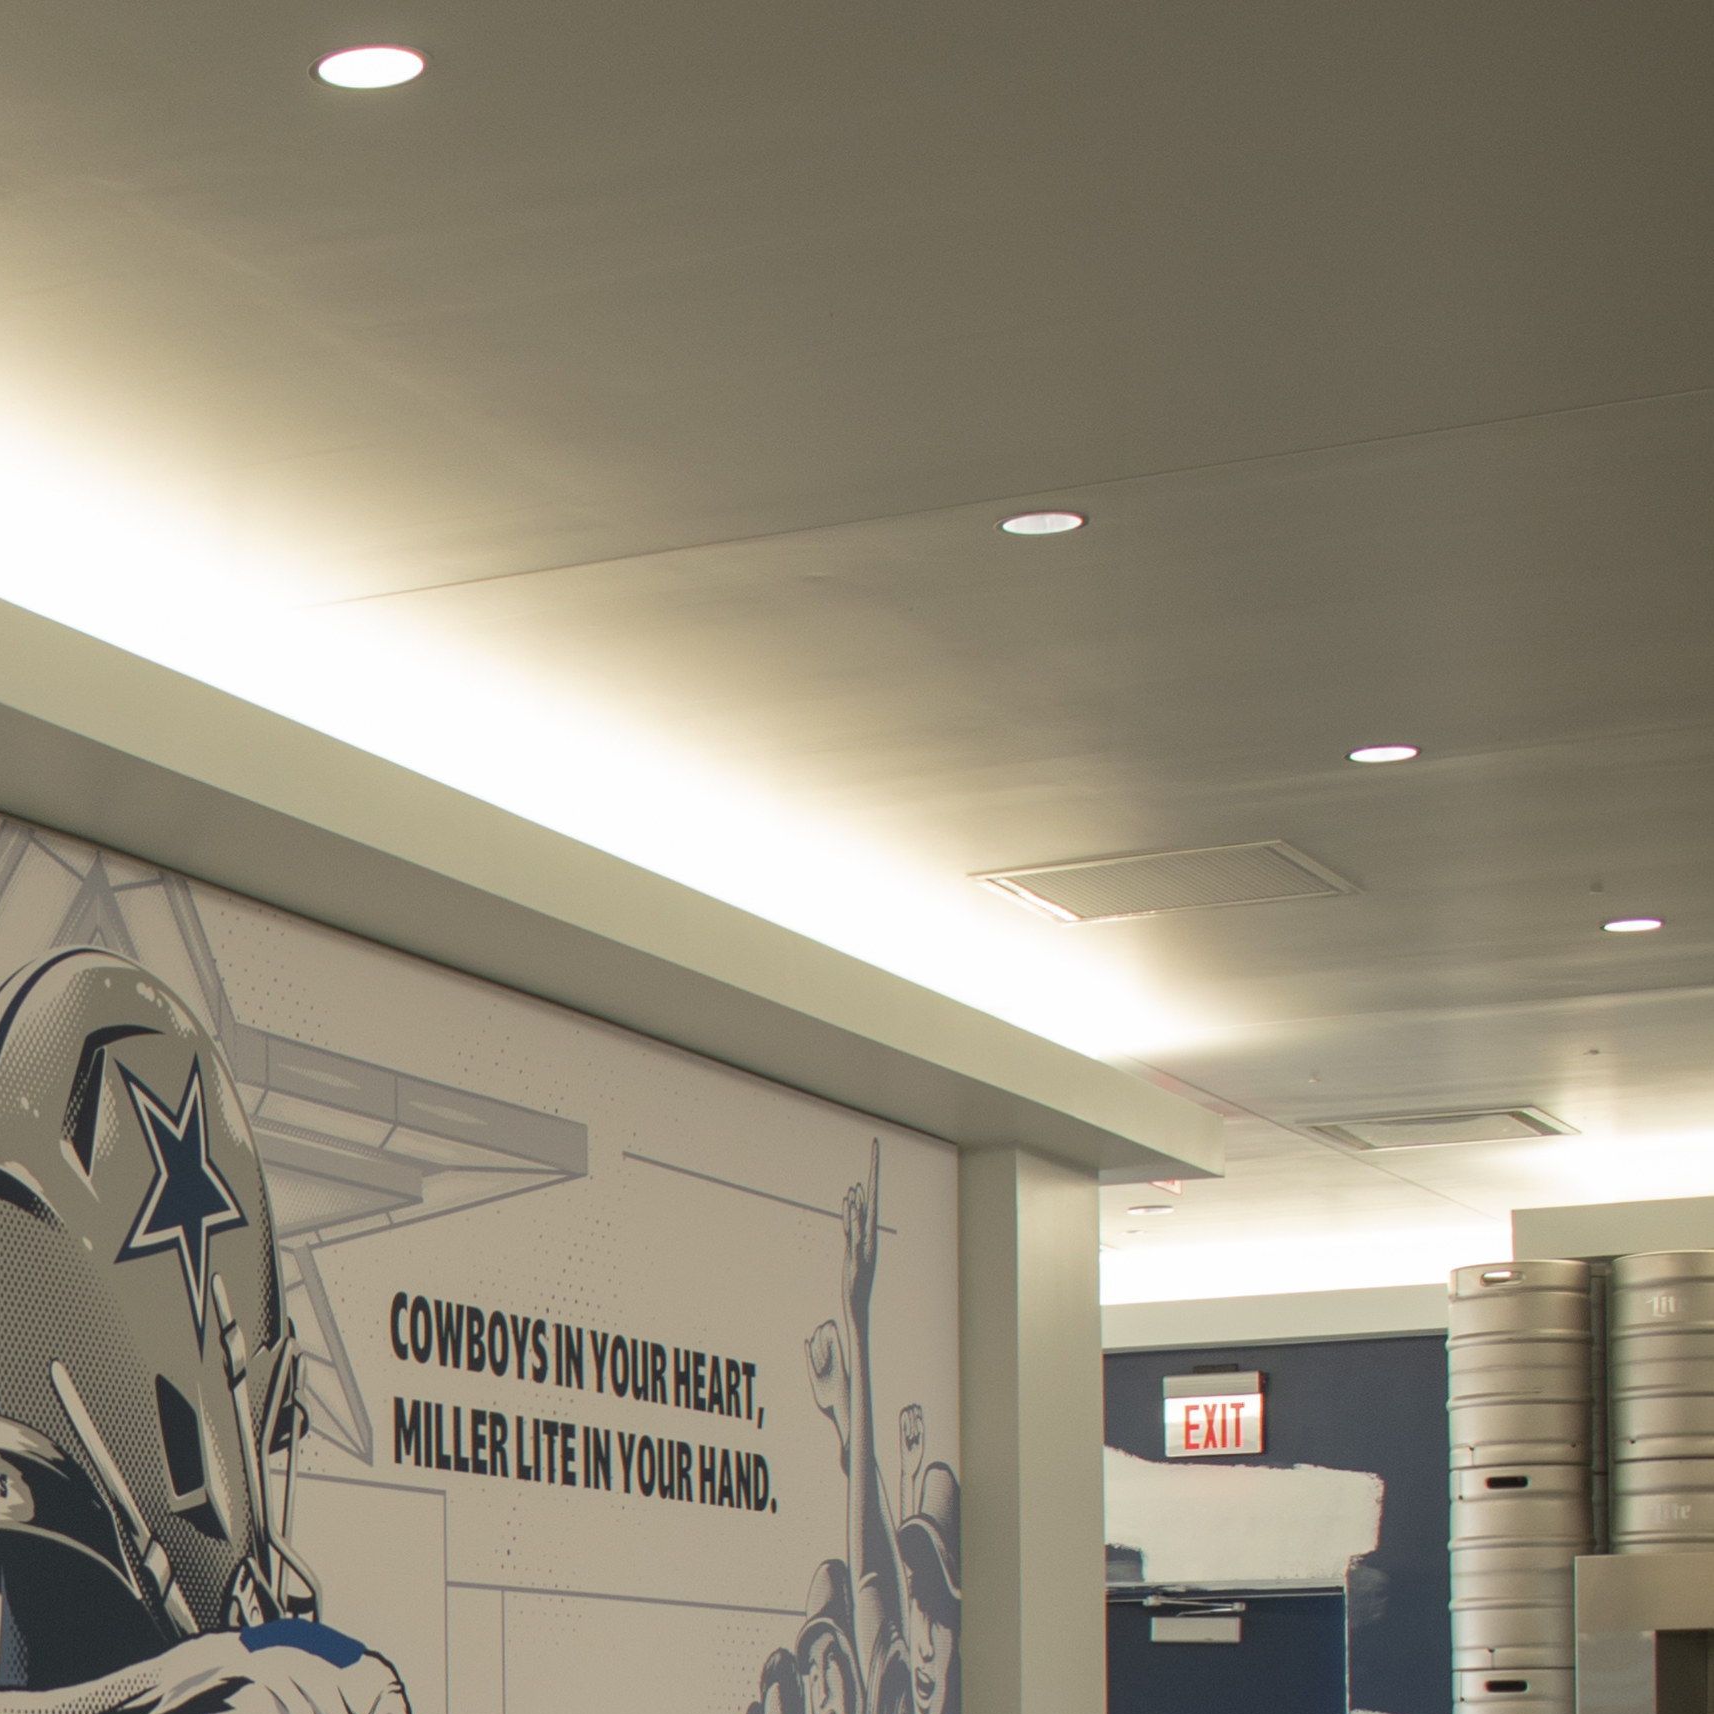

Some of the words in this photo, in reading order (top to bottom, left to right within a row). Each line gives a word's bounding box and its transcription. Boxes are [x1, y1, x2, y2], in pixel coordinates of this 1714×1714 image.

[390, 1291, 548, 1383] COWBOYS
[555, 1323, 584, 1390] IN
[590, 1329, 668, 1404] YOUR
[673, 1347, 765, 1429] HEART,
[393, 1396, 509, 1478] MILLER
[515, 1415, 577, 1487] LITE
[583, 1426, 611, 1492] IN
[617, 1431, 693, 1503] YOUR
[698, 1445, 778, 1514] HAND.
[1185, 1402, 1245, 1450] EXIT
